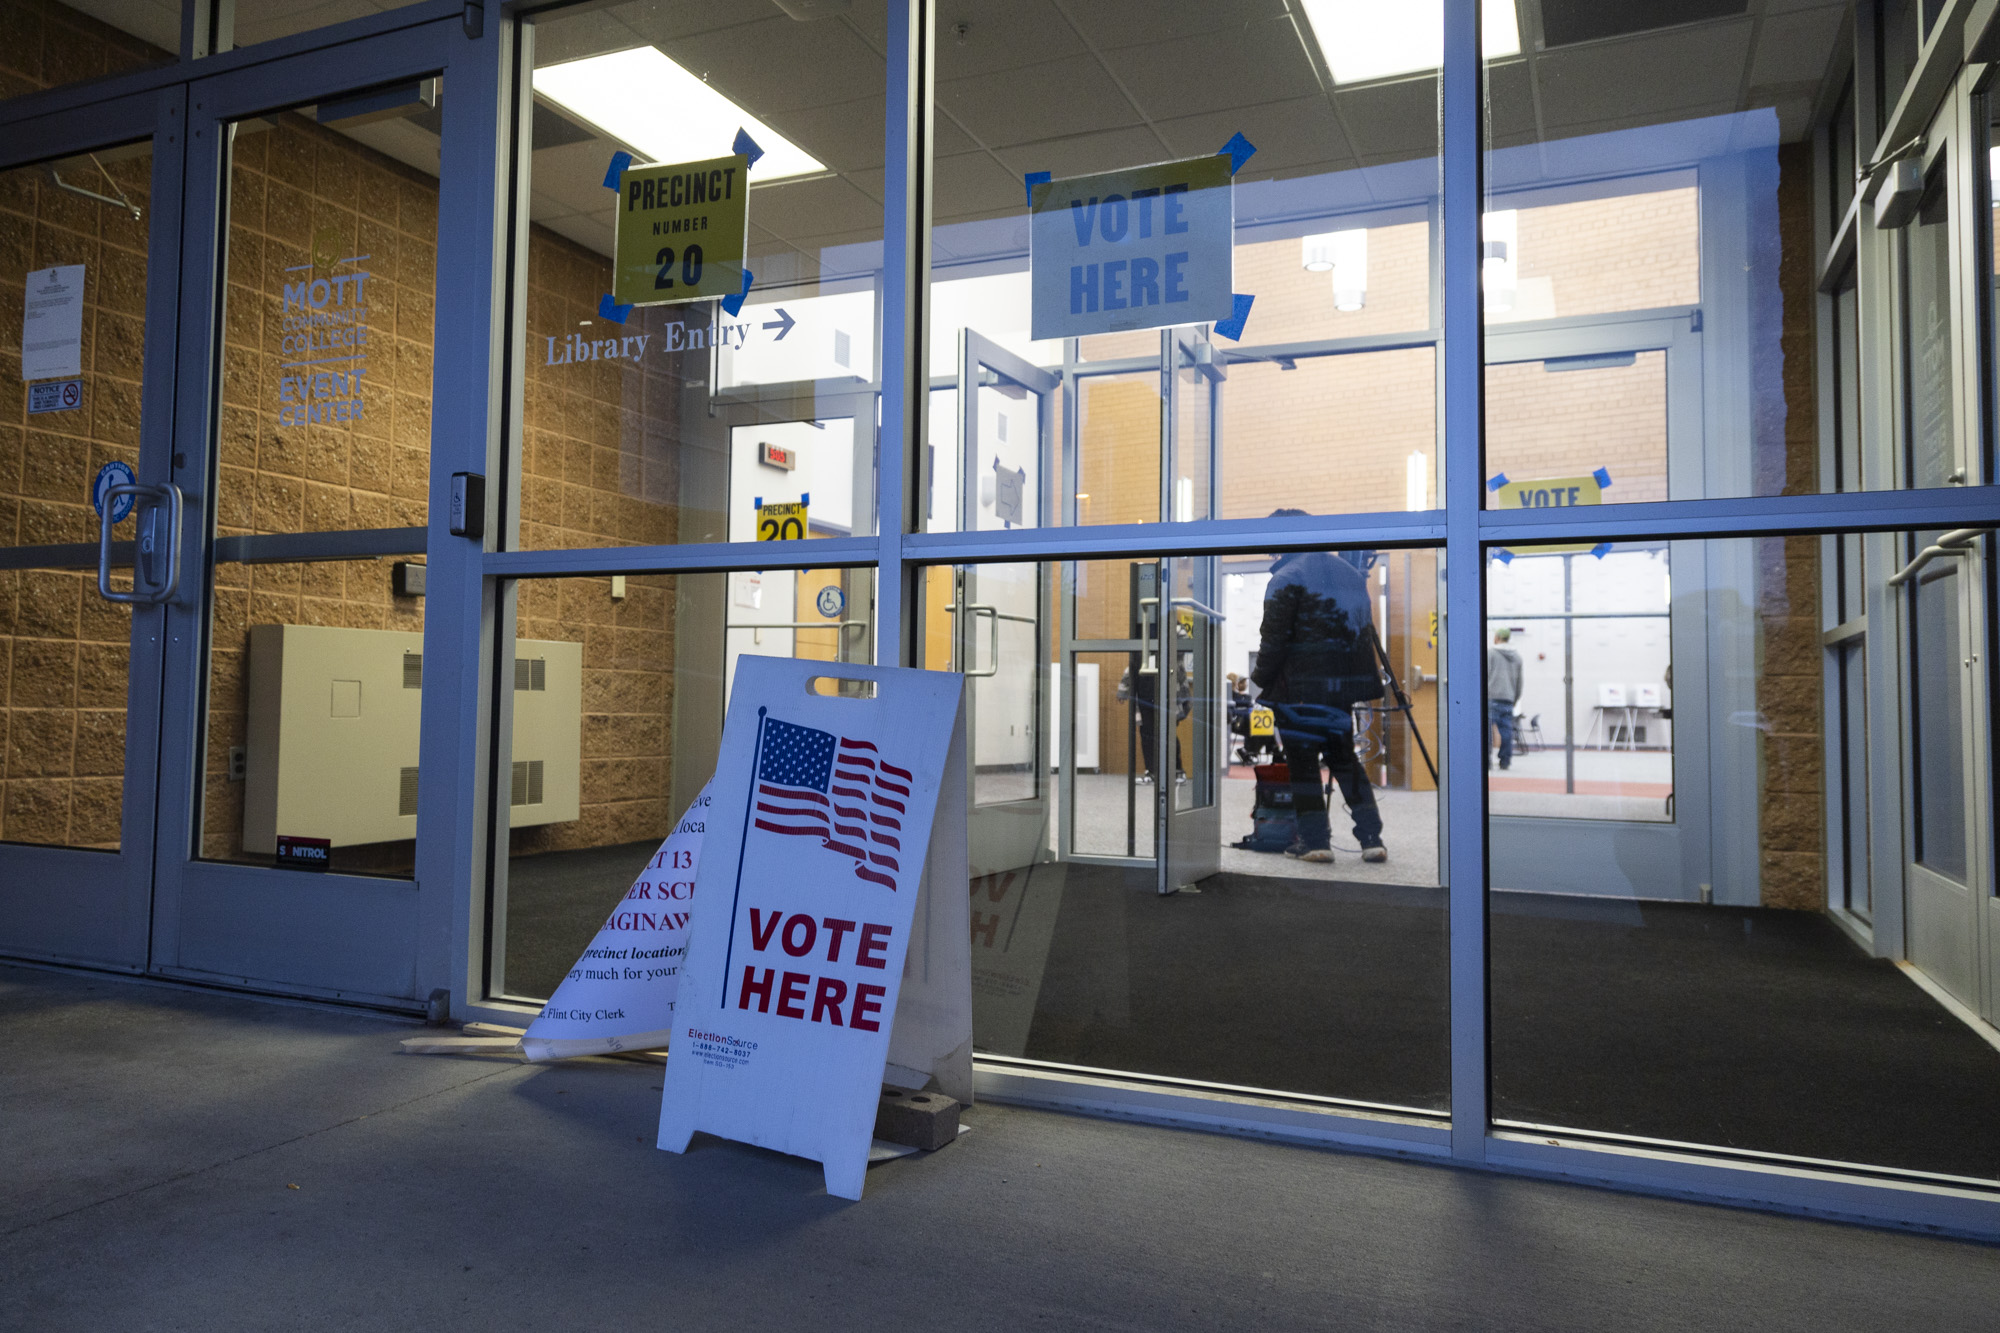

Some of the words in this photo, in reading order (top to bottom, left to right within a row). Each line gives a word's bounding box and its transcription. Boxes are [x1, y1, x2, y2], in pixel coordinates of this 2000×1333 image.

[628, 168, 736, 212] PRECINCT
[652, 216, 708, 236] NUMBER
[1071, 183, 1189, 247] VOTE
[654, 244, 703, 290] 20
[283, 272, 371, 313] MOTT
[1070, 251, 1189, 315] HERE
[282, 307, 369, 332] COMMUNITY
[281, 326, 368, 354] COLLEGE
[545, 334, 651, 366] Library
[663, 321, 752, 353] Entry
[34, 385, 60, 394] NOTICE
[280, 369, 367, 402] EVENT
[279, 399, 364, 427] CENTER
[100, 462, 131, 477] CAUTION
[763, 503, 800, 516] PRECINCT
[1518, 486, 1581, 509] VOTE
[760, 517, 804, 542] 20
[1253, 715, 1272, 728] 20
[279, 845, 327, 860] SNITROL
[672, 850, 692, 870] 13
[600, 912, 690, 932] AGINAW
[749, 907, 893, 970] VOTE
[567, 969, 584, 982] ery
[585, 967, 619, 980] much
[623, 967, 643, 980] for
[646, 966, 678, 982] your
[738, 965, 887, 1033] HERE
[547, 1008, 567, 1020] Flint
[569, 1009, 592, 1023] City
[595, 1008, 625, 1021] Clerk
[688, 1028, 759, 1051] ElectionSource
[692, 1041, 751, 1059] 1-888-742-8037
